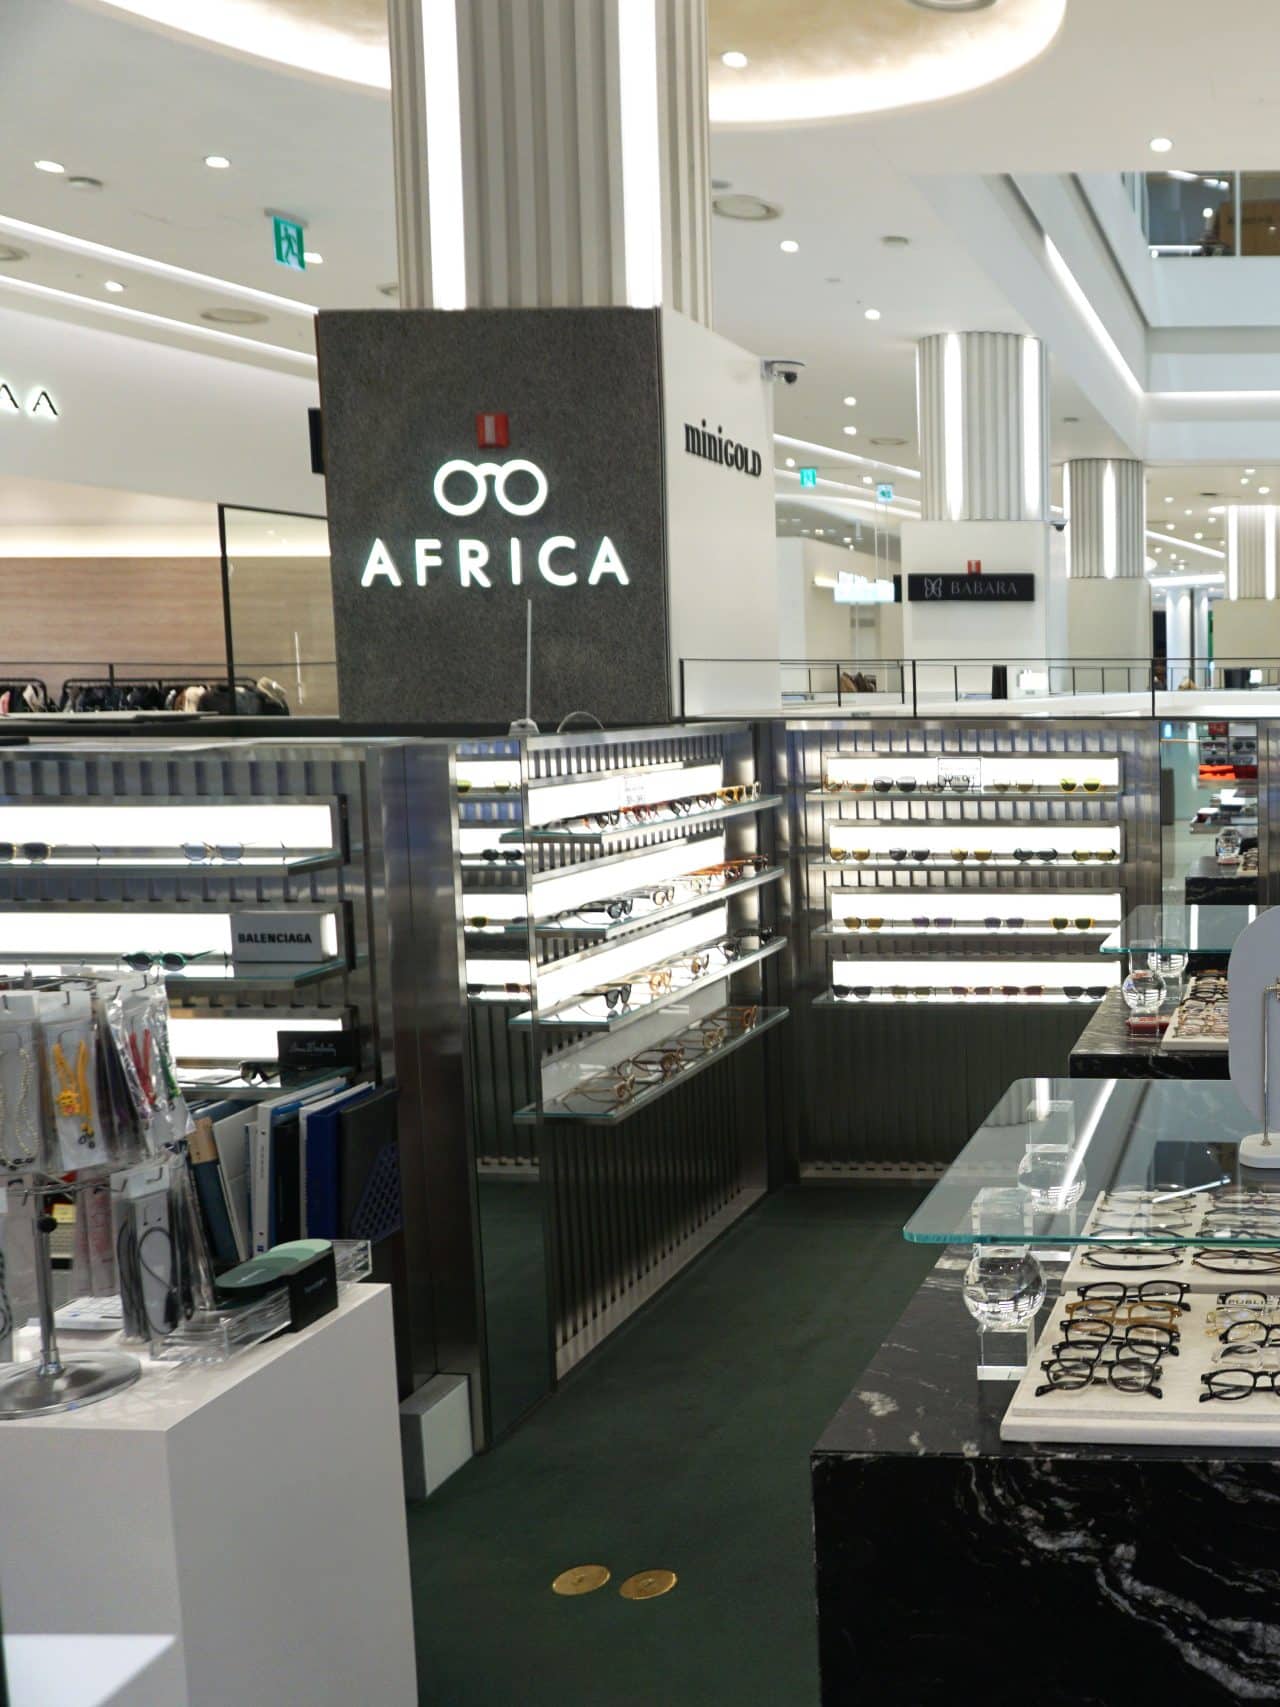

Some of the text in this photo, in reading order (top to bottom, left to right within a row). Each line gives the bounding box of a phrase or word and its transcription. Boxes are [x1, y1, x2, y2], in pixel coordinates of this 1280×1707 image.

[684, 418, 762, 478] miniGOLD
[360, 535, 630, 588] AFRICA
[951, 581, 1018, 595] BABARA
[237, 932, 312, 944] BALENCIAGA
